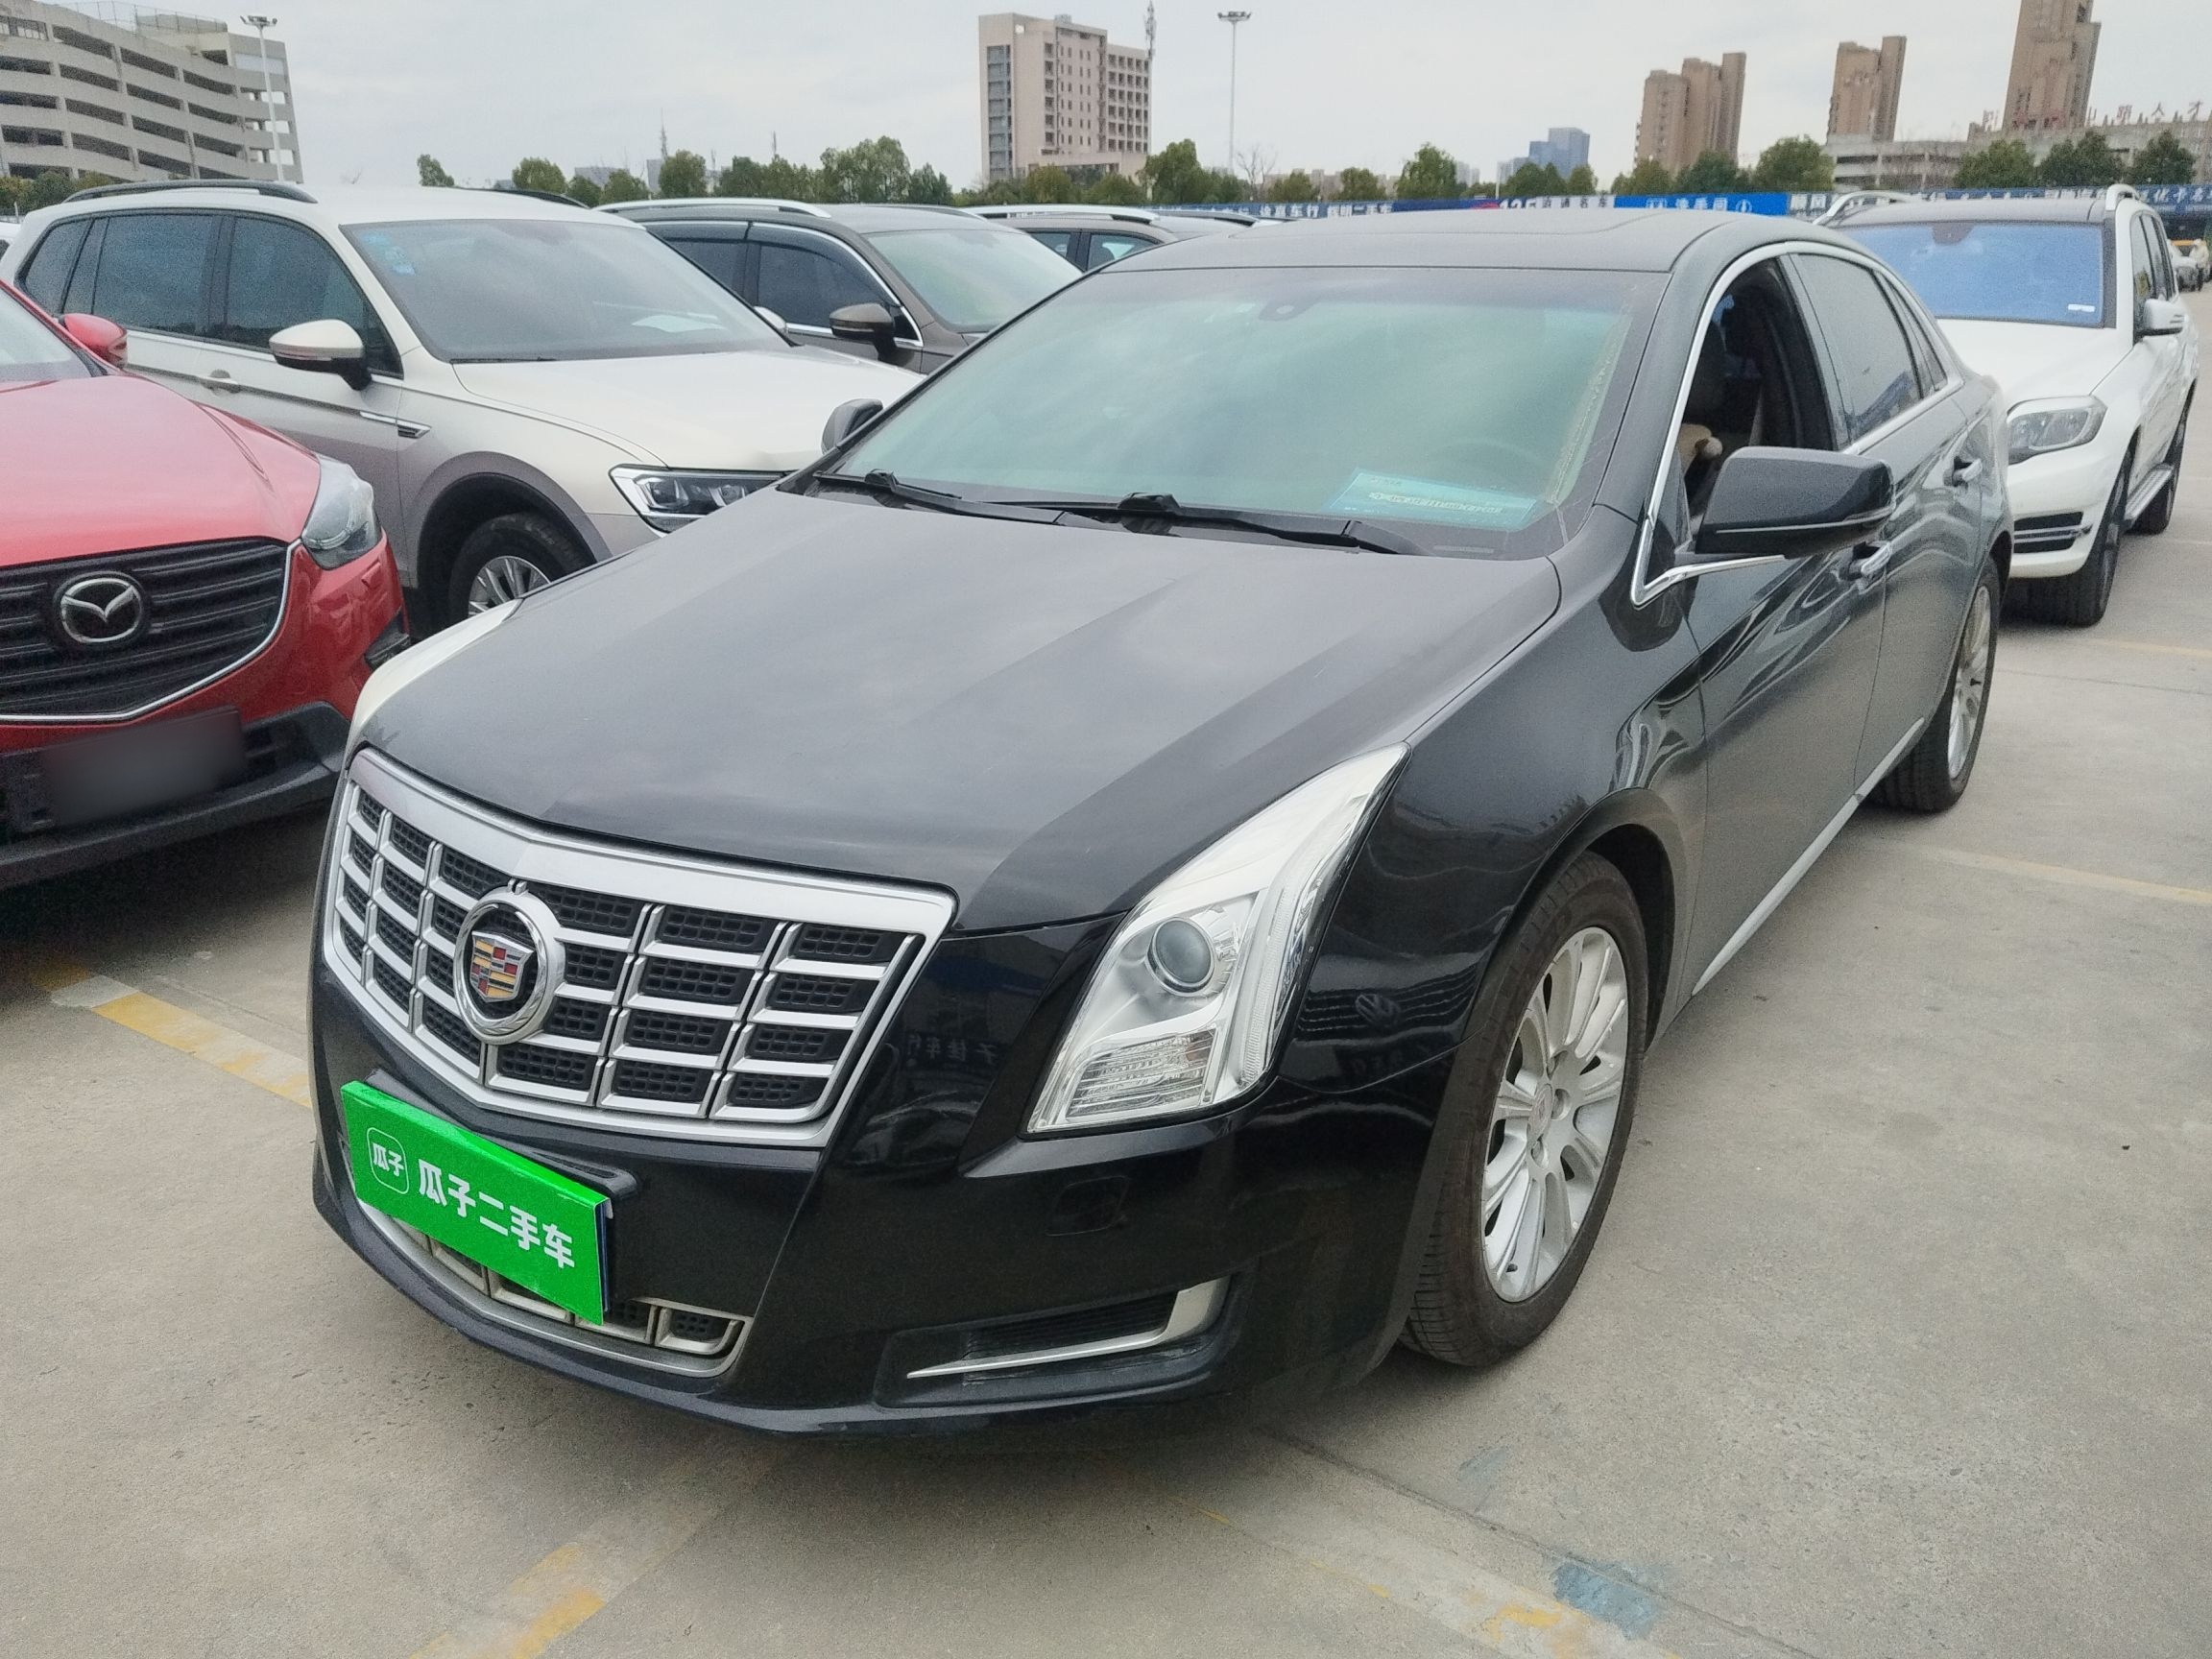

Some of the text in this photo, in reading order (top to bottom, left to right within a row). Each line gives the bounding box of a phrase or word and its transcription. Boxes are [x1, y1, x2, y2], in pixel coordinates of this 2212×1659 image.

[371, 1142, 405, 1177] 瓜子
[418, 1158, 575, 1269] 瓜子二手车
